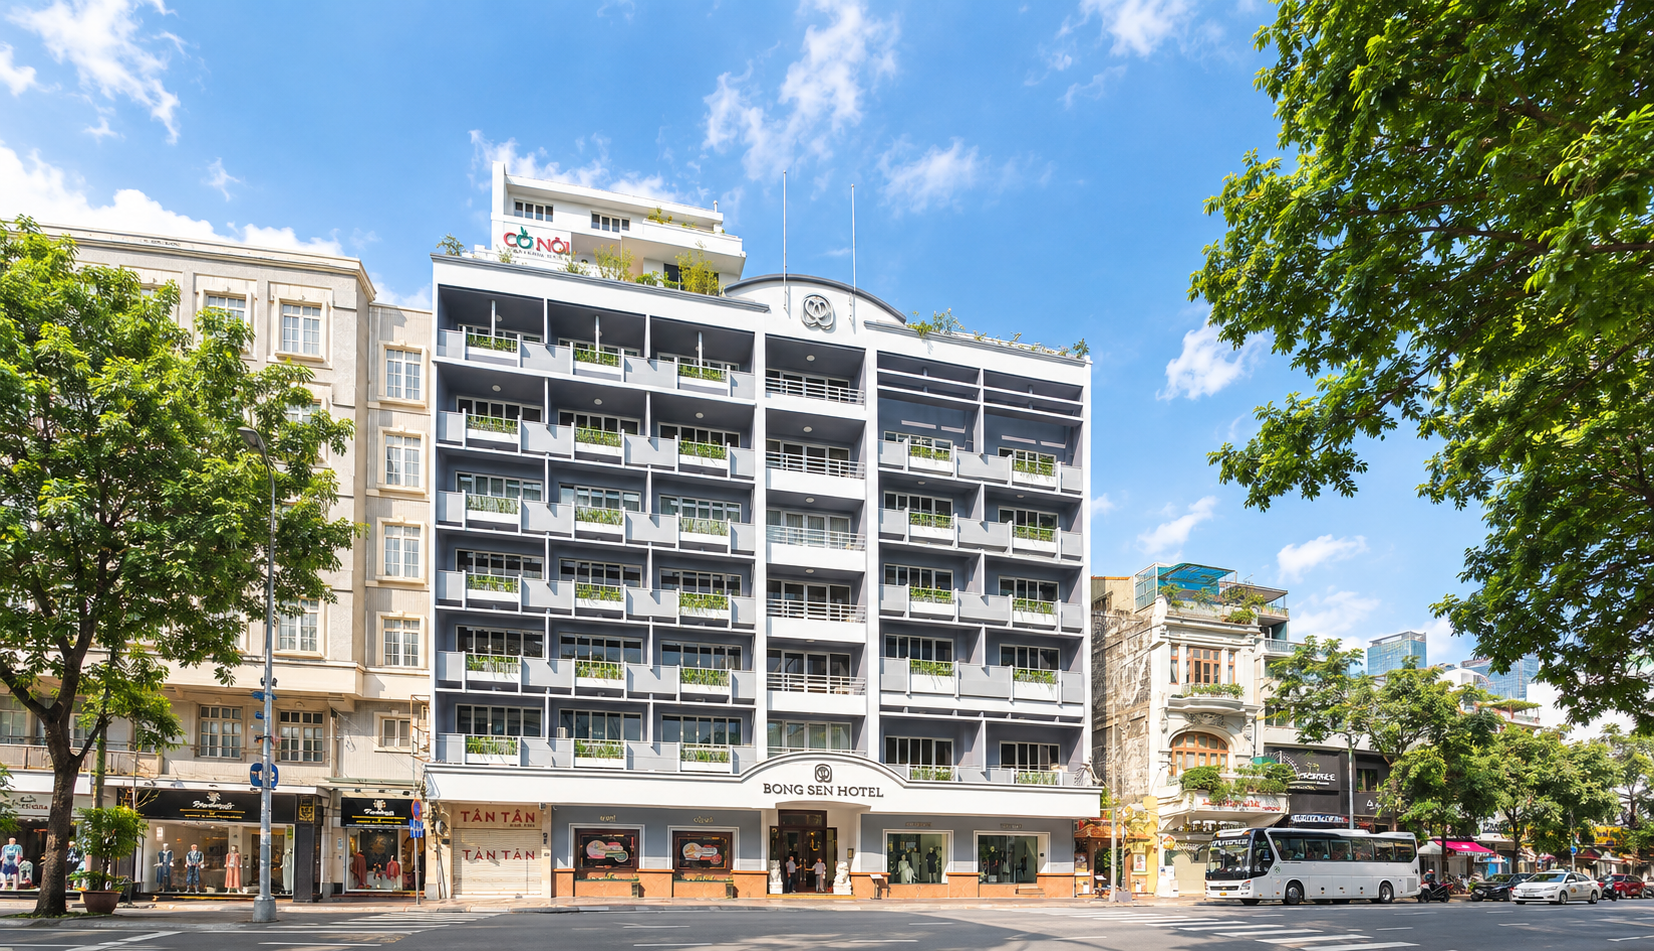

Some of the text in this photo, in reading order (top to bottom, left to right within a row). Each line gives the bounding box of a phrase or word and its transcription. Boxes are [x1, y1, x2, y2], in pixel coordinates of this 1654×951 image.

[763, 783, 884, 798] BONG SEN HOTEL
[460, 808, 535, 823] TÂN TÂN
